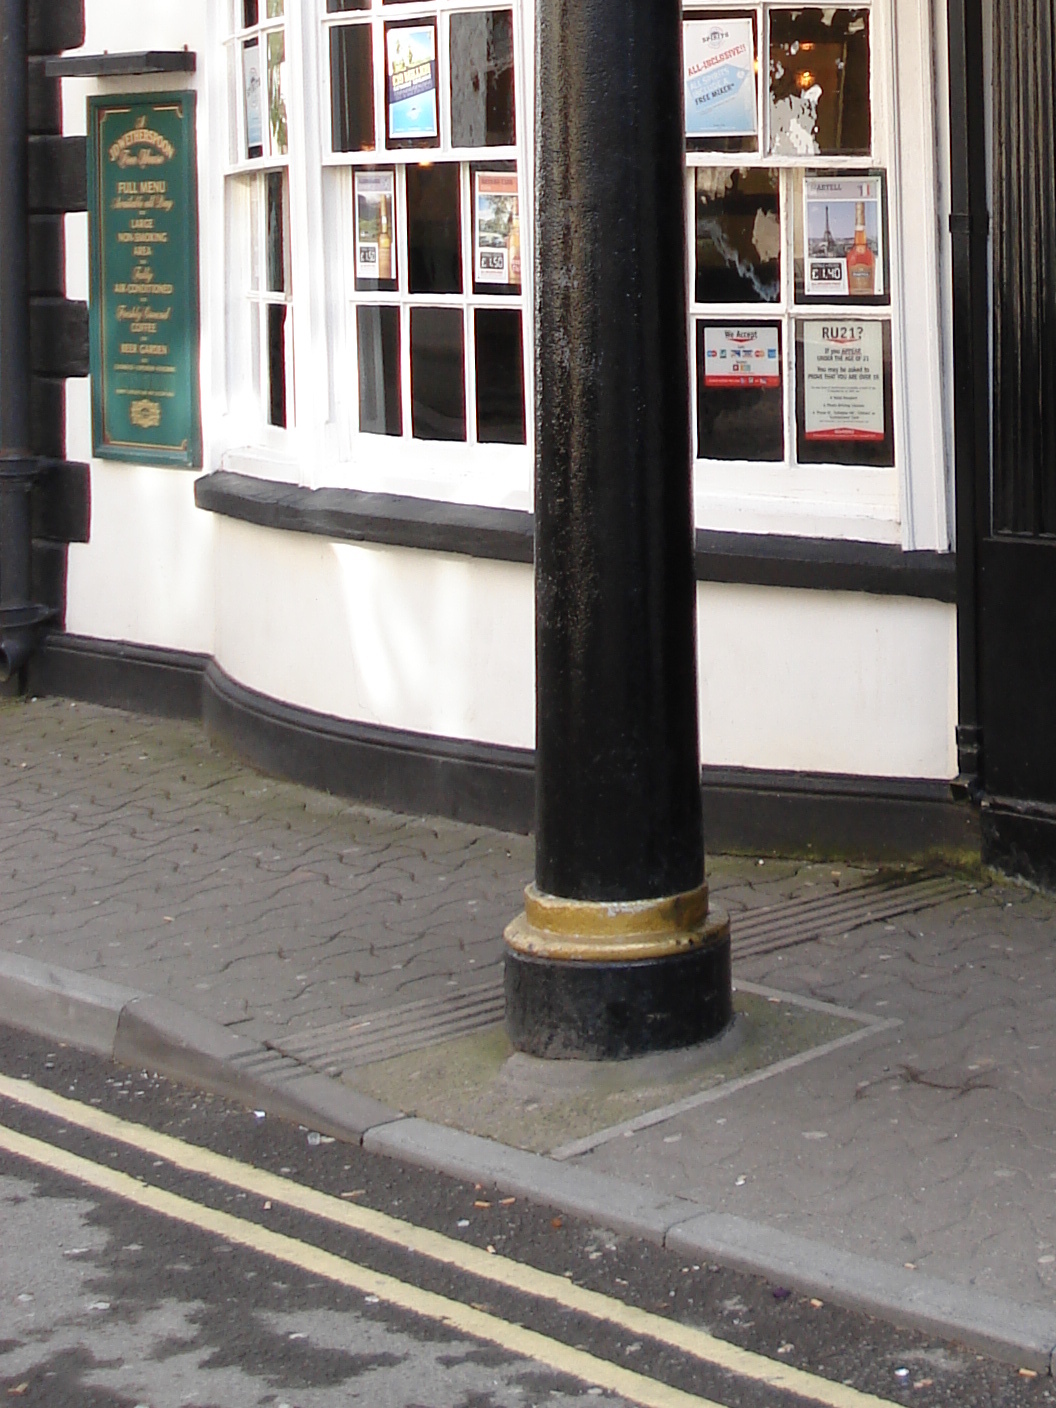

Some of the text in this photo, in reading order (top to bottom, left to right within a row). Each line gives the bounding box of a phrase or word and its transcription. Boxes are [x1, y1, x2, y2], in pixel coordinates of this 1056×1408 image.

[117, 180, 166, 193] FULL MENU
[130, 219, 154, 230] LARGE
[724, 330, 758, 340] We Accept
[822, 327, 864, 340] RU21?
